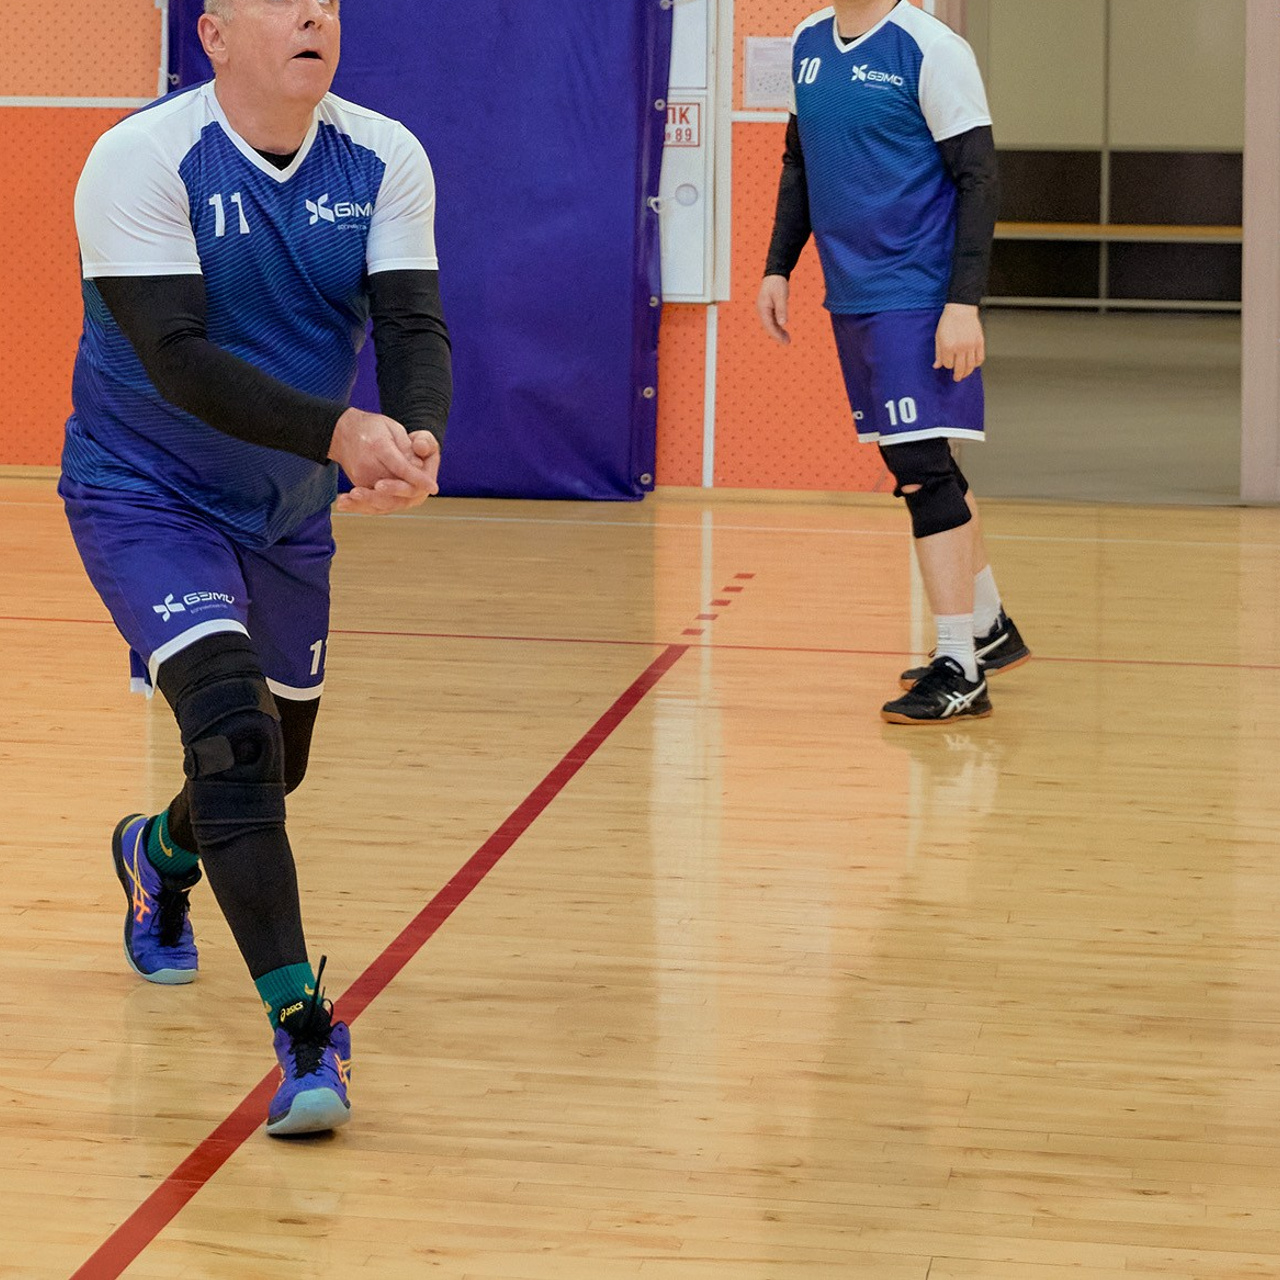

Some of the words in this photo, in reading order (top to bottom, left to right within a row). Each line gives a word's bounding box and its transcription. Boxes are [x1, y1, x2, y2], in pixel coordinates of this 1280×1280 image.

[797, 57, 822, 85] 10
[666, 106, 690, 125] ПК
[675, 127, 692, 142] 89
[208, 192, 250, 237] 11
[885, 396, 918, 426] 10
[310, 639, 327, 676] 1
